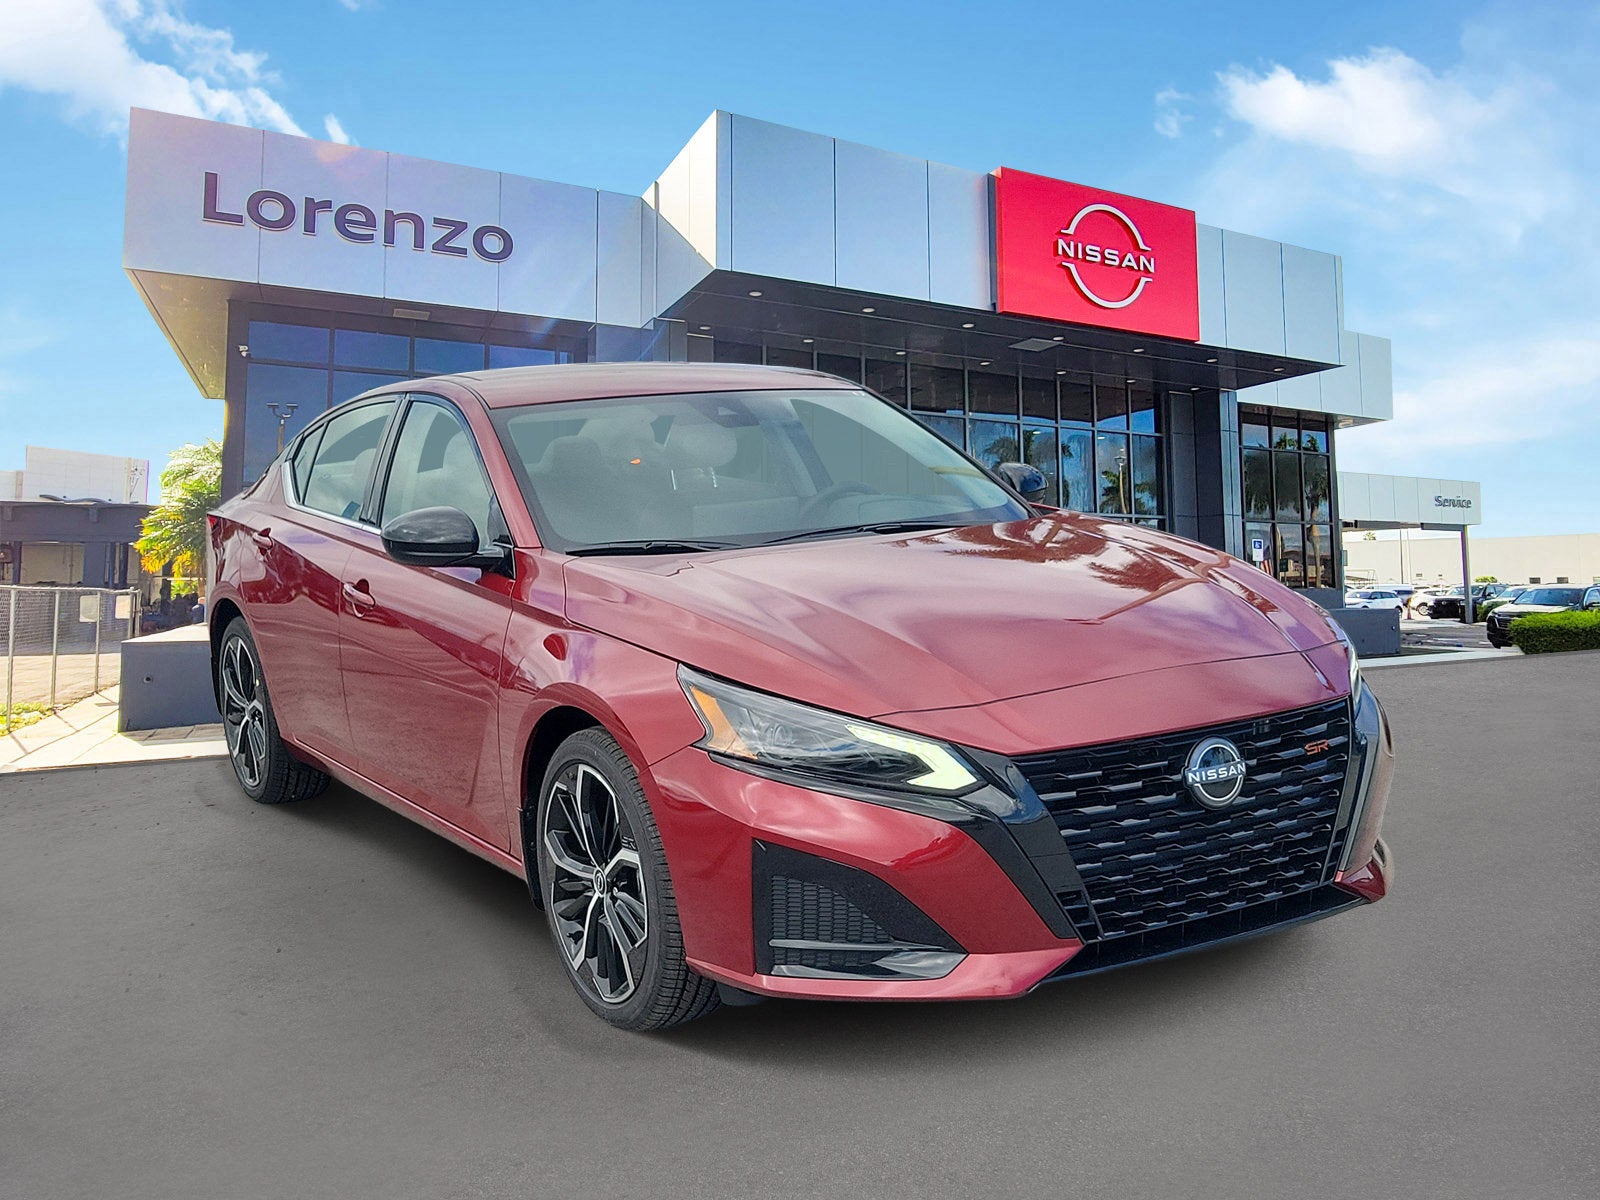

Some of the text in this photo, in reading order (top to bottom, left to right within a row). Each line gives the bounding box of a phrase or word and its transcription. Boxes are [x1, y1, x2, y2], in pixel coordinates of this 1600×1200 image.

[202, 171, 514, 262] Lorenzo
[1057, 238, 1155, 273] NISSAN
[1434, 495, 1472, 509] Service
[1304, 739, 1329, 756] SR
[1188, 762, 1246, 783] NISSAN
